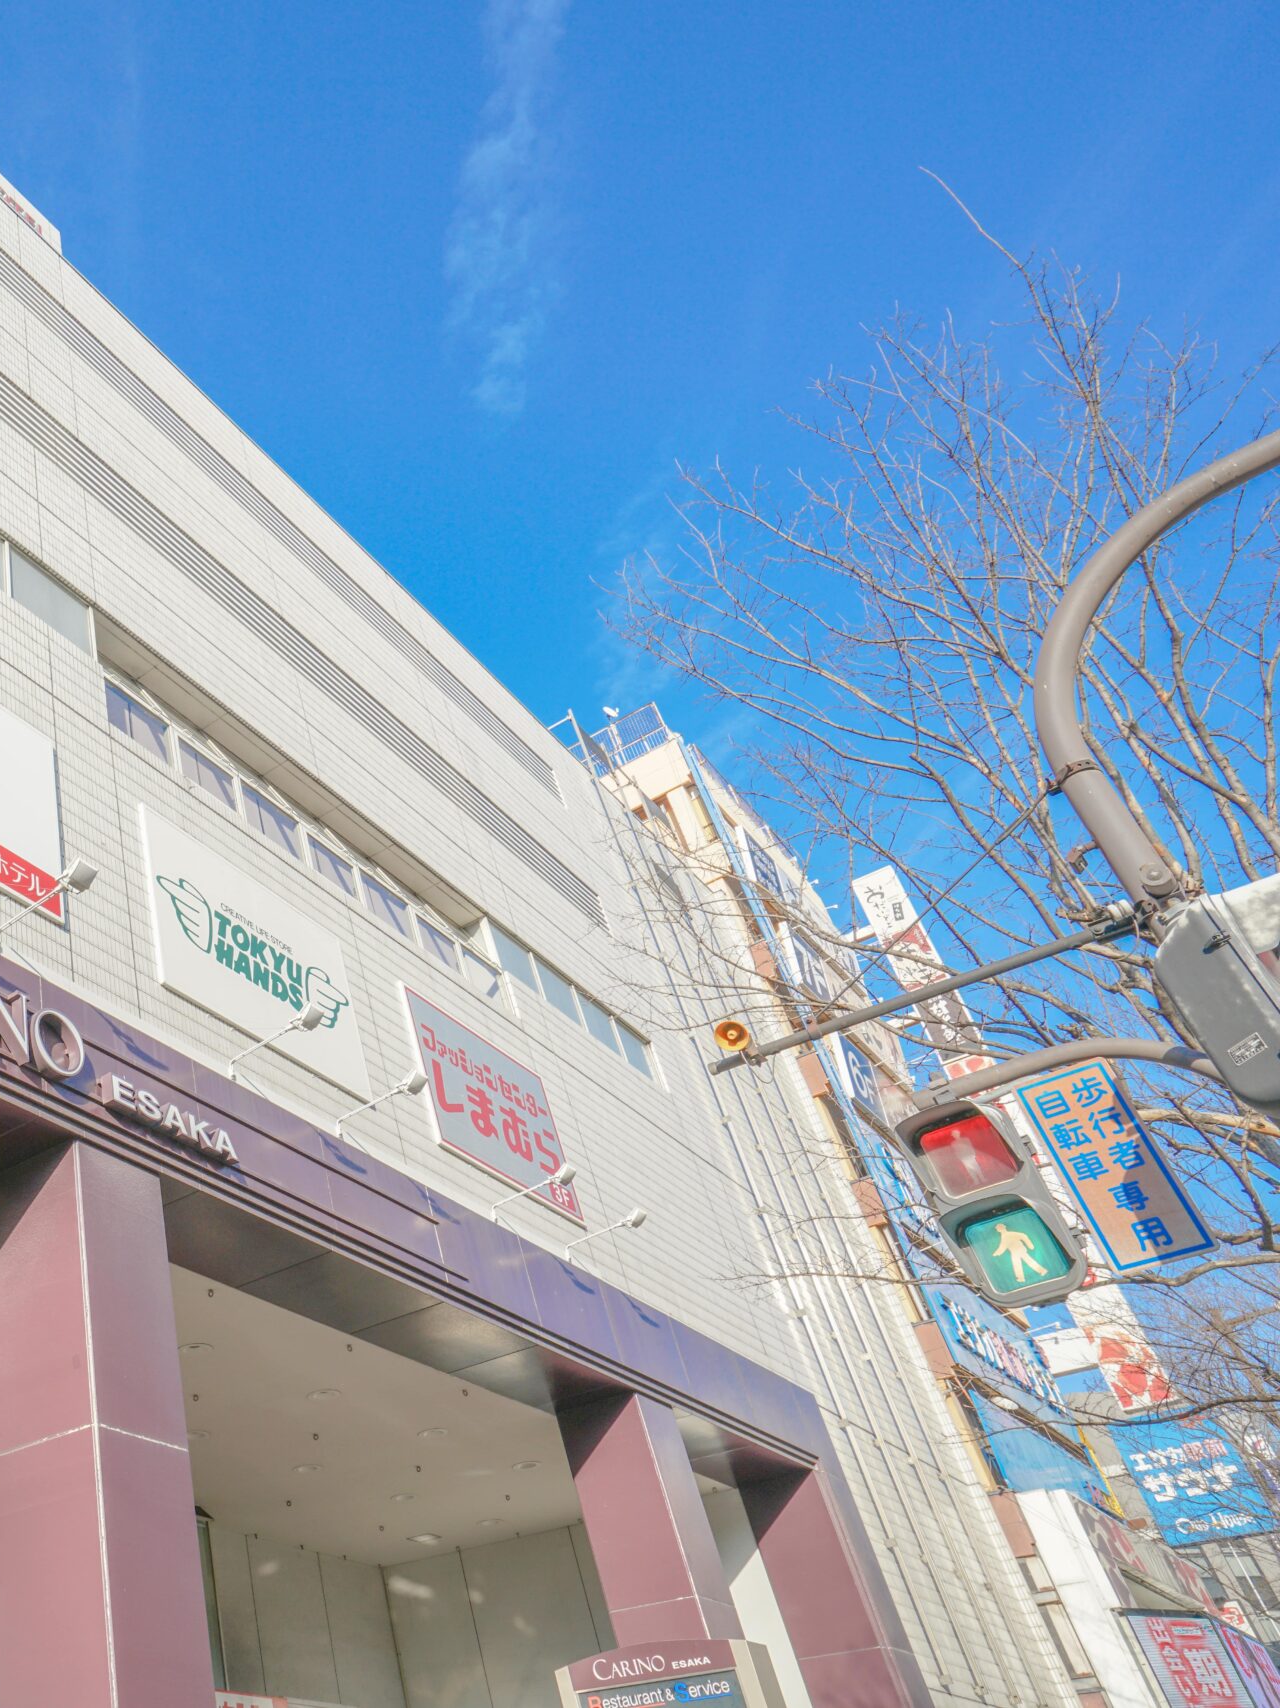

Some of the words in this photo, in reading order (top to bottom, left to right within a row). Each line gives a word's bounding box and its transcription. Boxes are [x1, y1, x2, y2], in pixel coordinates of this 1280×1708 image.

[214, 910, 303, 988] TOKYU
[214, 938, 304, 1012] HANDS
[421, 1023, 548, 1119] ファッションセンター
[108, 1073, 239, 1161] ESAKA
[431, 1060, 560, 1175] しまむら
[1034, 1090, 1111, 1183] 自転車
[1070, 1074, 1147, 1172] 歩行者
[551, 1182, 572, 1207] 3F
[1108, 1180, 1175, 1253] 専用
[1142, 1462, 1238, 1503] サウナ
[587, 1688, 663, 1708] Restaurant
[665, 1690, 675, 1702] &
[673, 1679, 731, 1703] Service
[592, 1655, 666, 1681] CARINO
[671, 1656, 711, 1670] ESAKA
